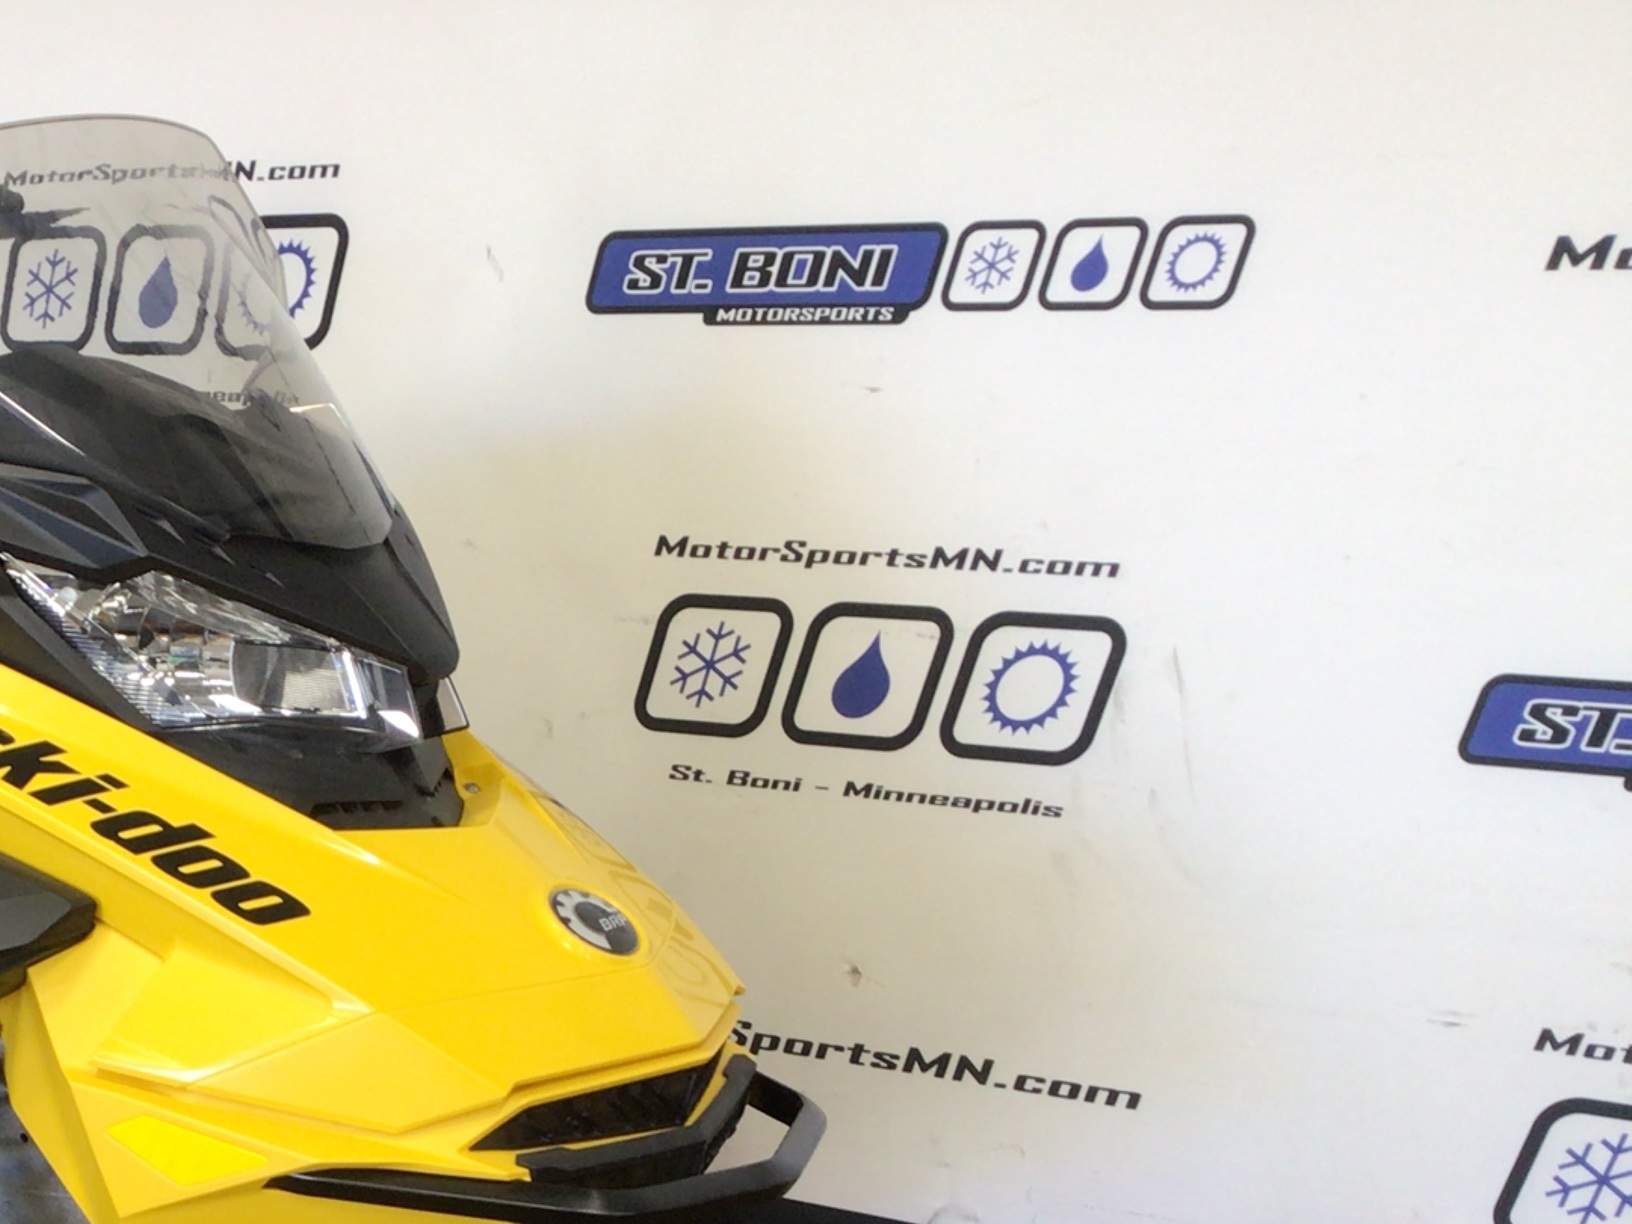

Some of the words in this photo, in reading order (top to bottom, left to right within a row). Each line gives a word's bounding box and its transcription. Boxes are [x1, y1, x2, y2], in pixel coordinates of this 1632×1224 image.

[622, 249, 713, 295] ST.
[727, 243, 898, 294] BONI
[714, 305, 895, 323] MOTORSPORTS
[653, 534, 1121, 580] MotorSportsMN.com
[668, 764, 712, 784] St.
[726, 769, 803, 793] Boni
[842, 780, 1065, 819] Minneapolis
[598, 914, 627, 932] BRP
